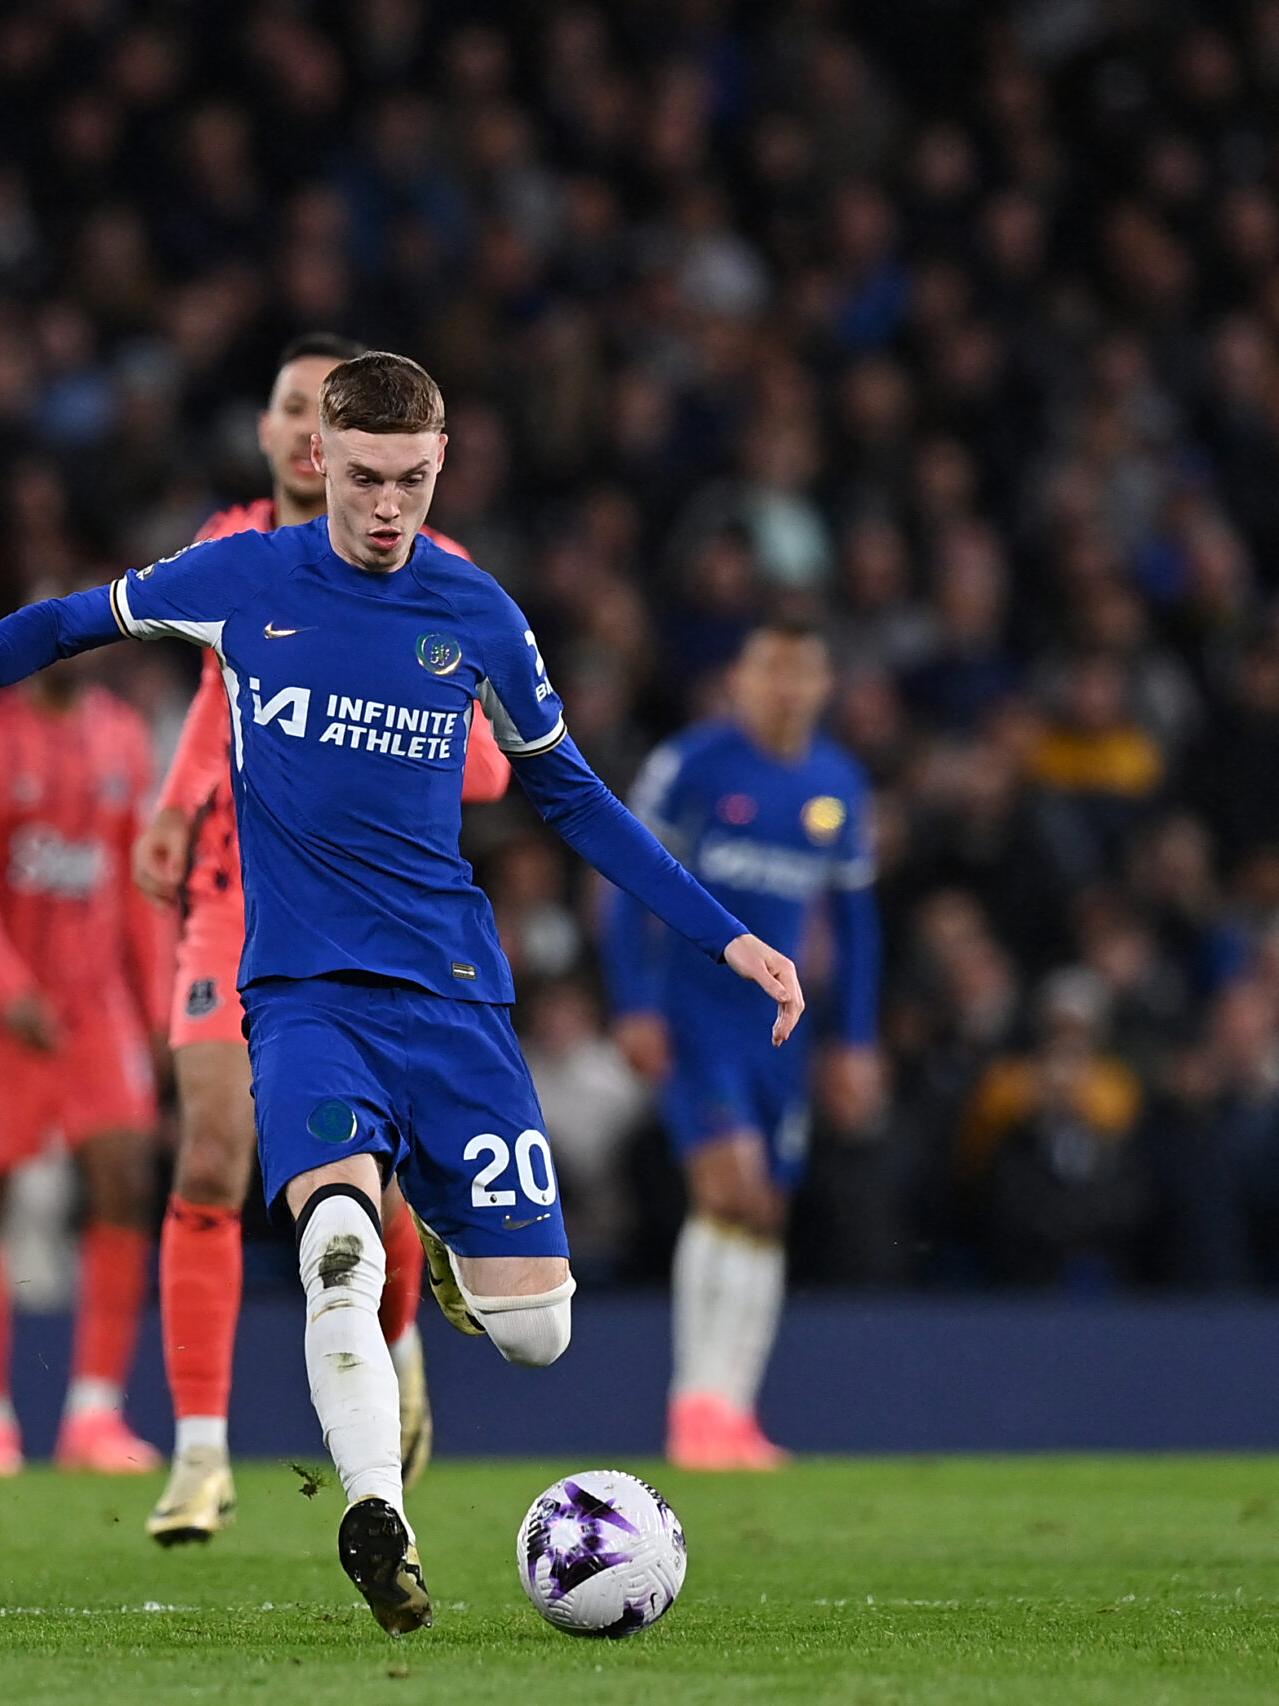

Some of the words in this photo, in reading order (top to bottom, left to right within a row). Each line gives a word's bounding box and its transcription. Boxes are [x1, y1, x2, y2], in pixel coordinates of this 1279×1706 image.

[326, 694, 458, 735] INFINITE
[319, 722, 452, 760] ATHLETE
[463, 1129, 557, 1208] 20
